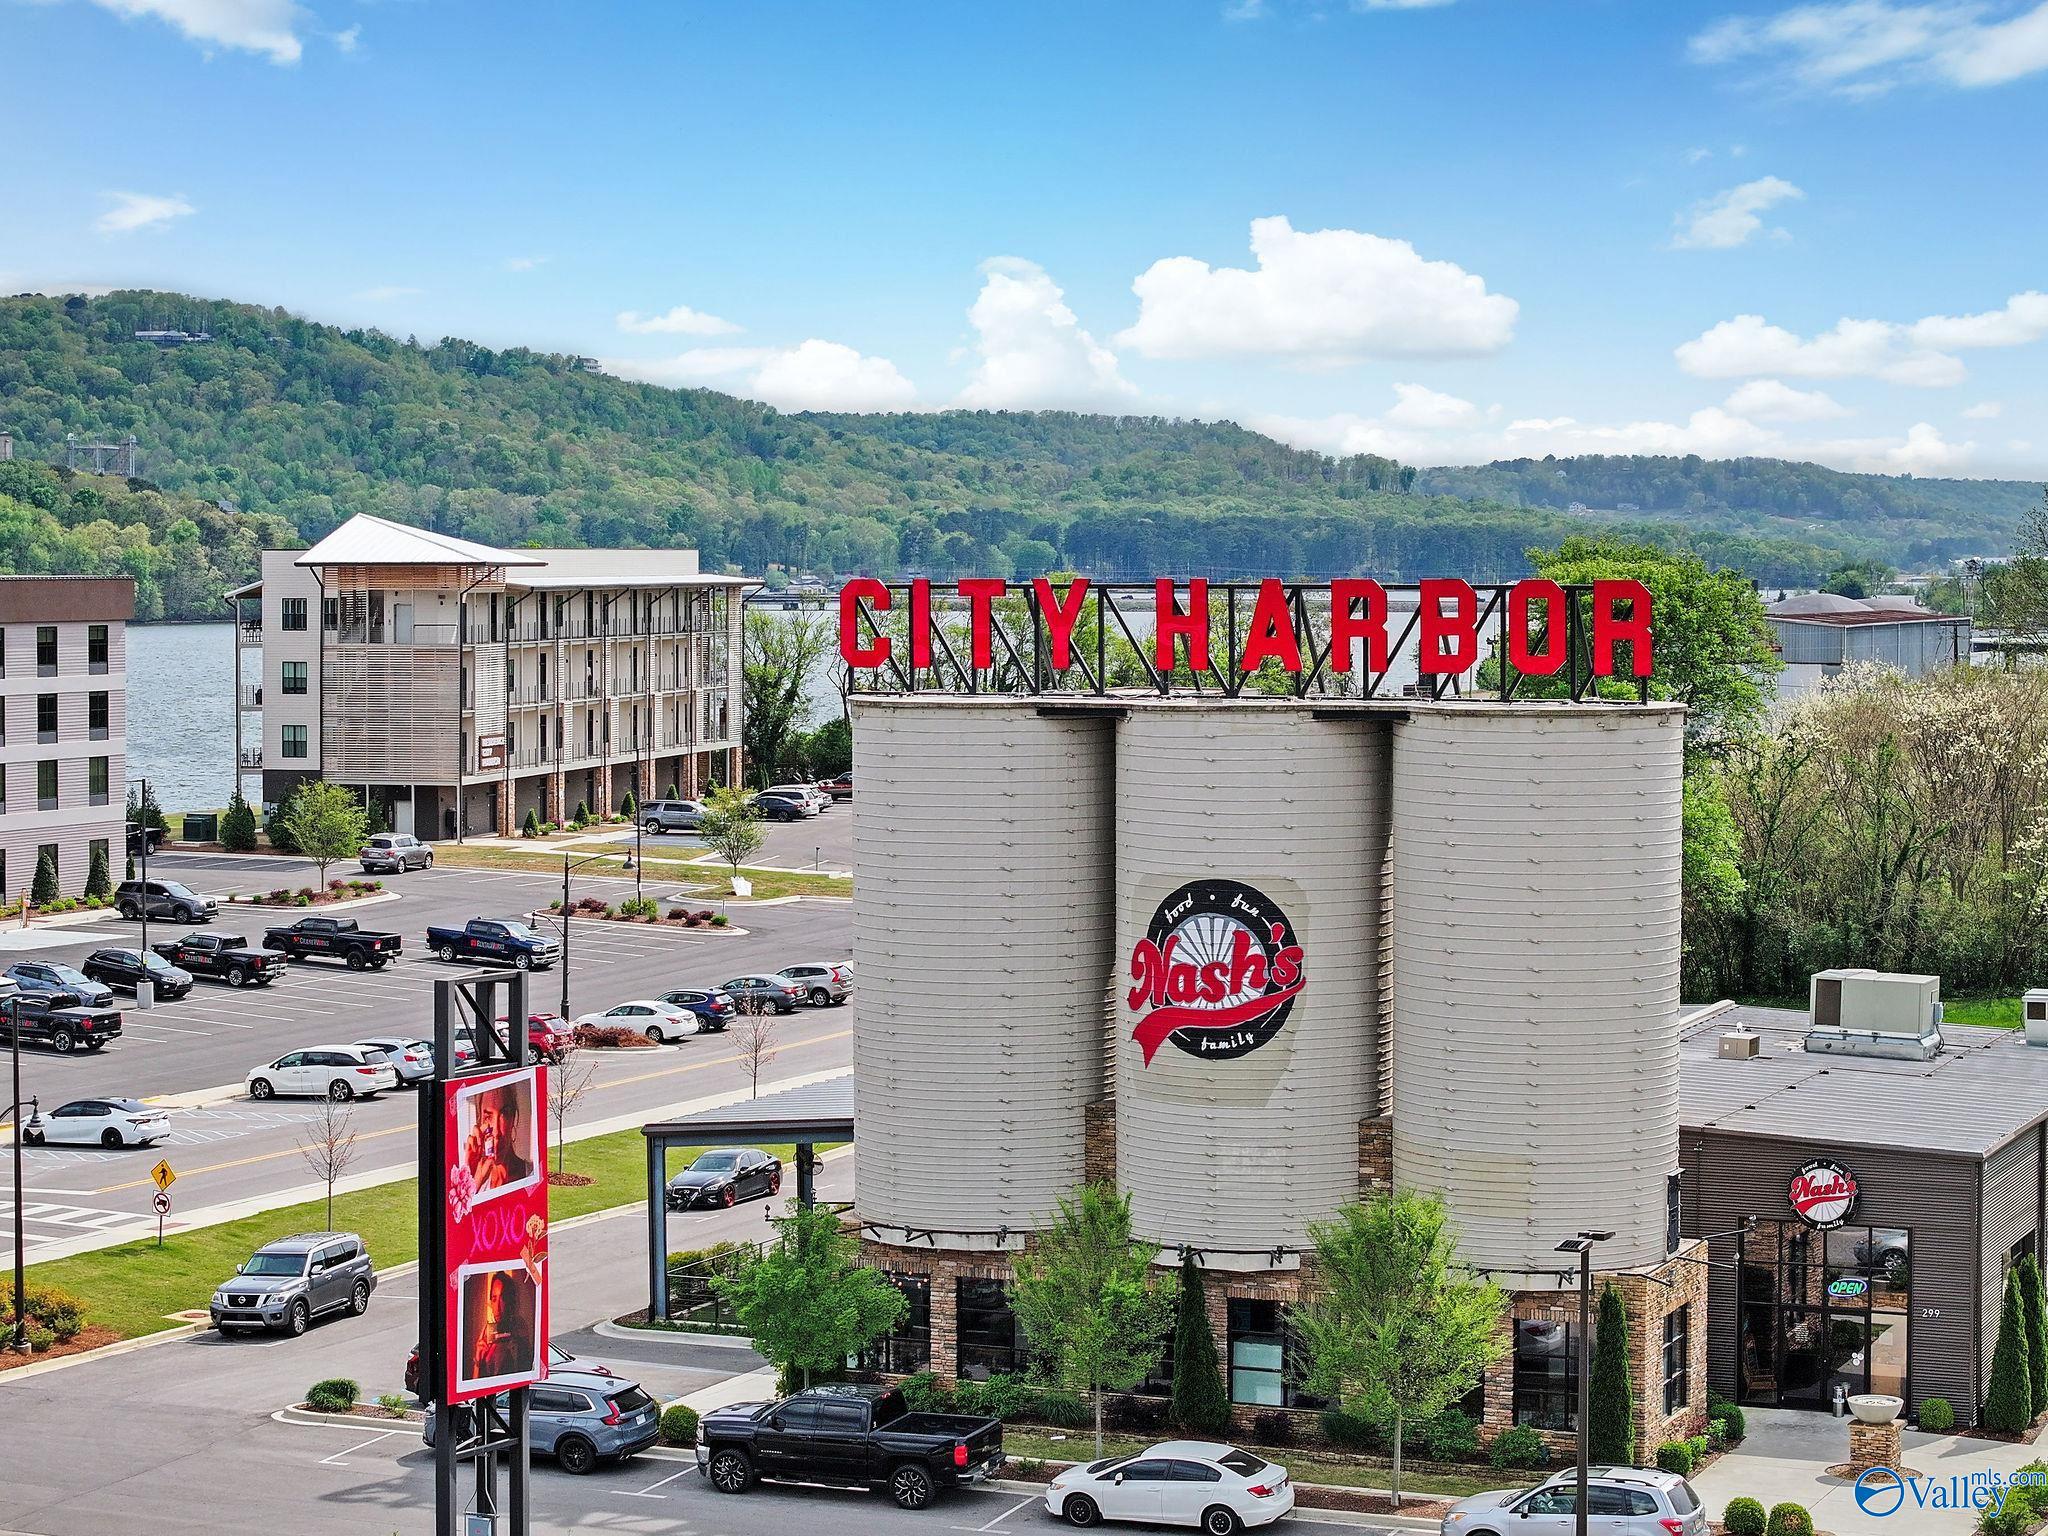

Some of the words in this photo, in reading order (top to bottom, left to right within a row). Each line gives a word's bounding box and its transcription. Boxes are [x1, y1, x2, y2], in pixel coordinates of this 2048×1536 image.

[840, 577, 1092, 671] CITY
[1155, 577, 1654, 676] HARBOR
[1164, 892, 1194, 924] food
[1230, 892, 1260, 918] fun
[1128, 922, 1304, 1011] Nash's
[1201, 1032, 1255, 1052] family
[1801, 1161, 1818, 1174] food
[1829, 1163, 1844, 1175] fun
[1789, 1172, 1857, 1201] Nash's
[469, 1204, 526, 1257] XOXO
[1816, 1219, 1845, 1230] family
[1830, 1281, 1863, 1294] OPEN
[1922, 1308, 1940, 1318] 299
